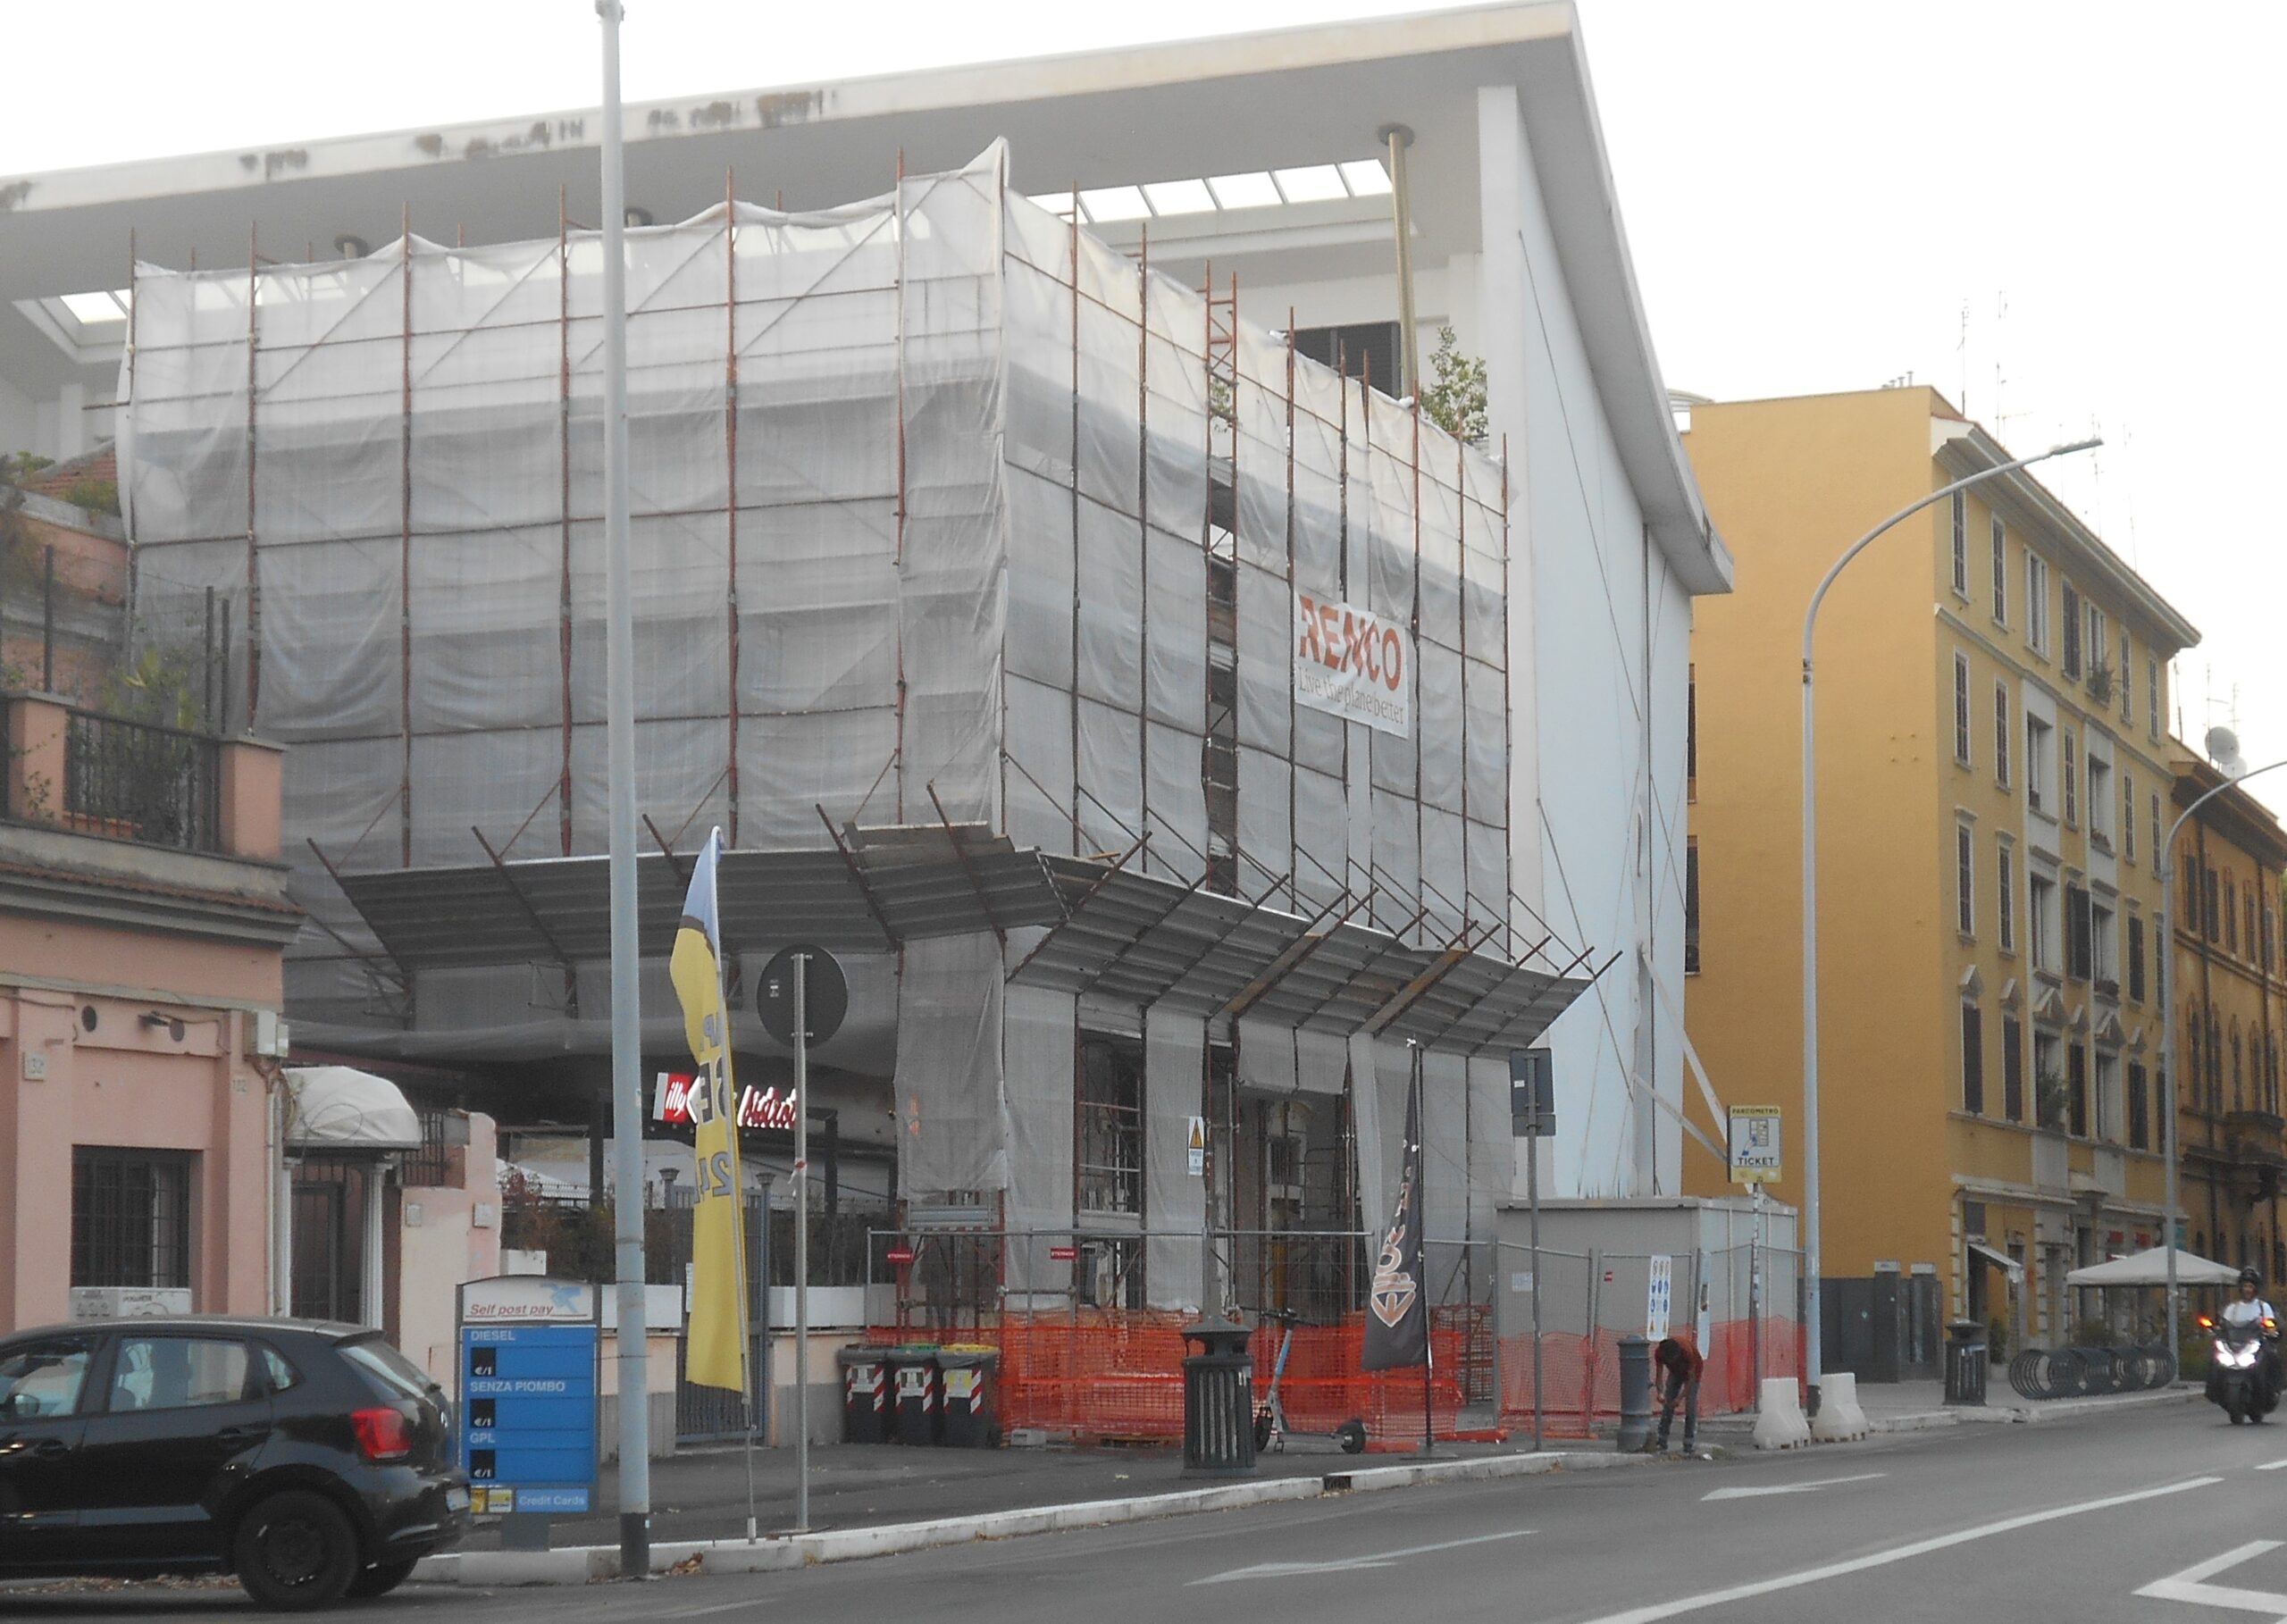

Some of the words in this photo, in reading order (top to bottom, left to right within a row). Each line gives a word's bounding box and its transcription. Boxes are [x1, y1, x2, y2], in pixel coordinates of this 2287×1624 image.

[1299, 595, 1402, 691] RENCO
[1299, 667, 1322, 697] Live
[1324, 675, 1345, 703] the
[666, 1082, 686, 1117] illy
[1738, 1157, 1774, 1166] TICKET
[470, 1304, 496, 1315] Self
[498, 1305, 527, 1317] post
[529, 1306, 553, 1317] pay
[471, 1330, 515, 1341] DIESEL
[470, 1381, 512, 1393] SENZA
[515, 1381, 565, 1393] PIOMBO
[470, 1433, 496, 1444] GPL
[518, 1494, 550, 1506] Credit
[553, 1494, 584, 1506] Cards
